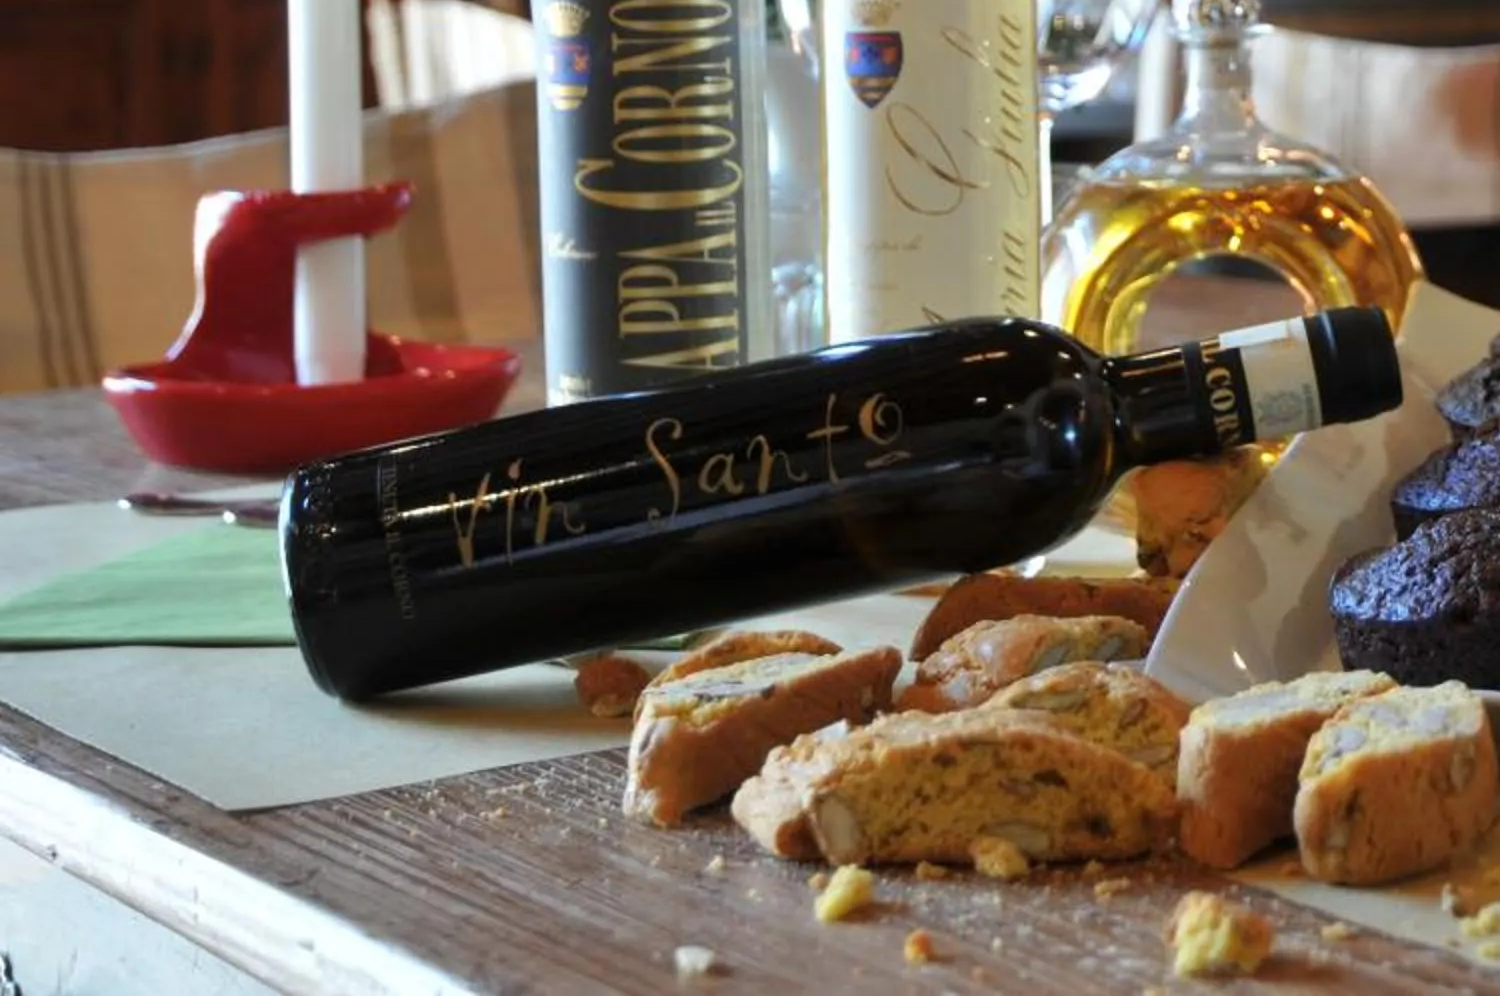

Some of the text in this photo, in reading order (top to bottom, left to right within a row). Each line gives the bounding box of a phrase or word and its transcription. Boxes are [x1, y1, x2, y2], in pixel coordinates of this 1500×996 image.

[616, 228, 740, 371] APPA
[1206, 367, 1239, 446] CORN
[448, 392, 911, 569] Vin Santo
